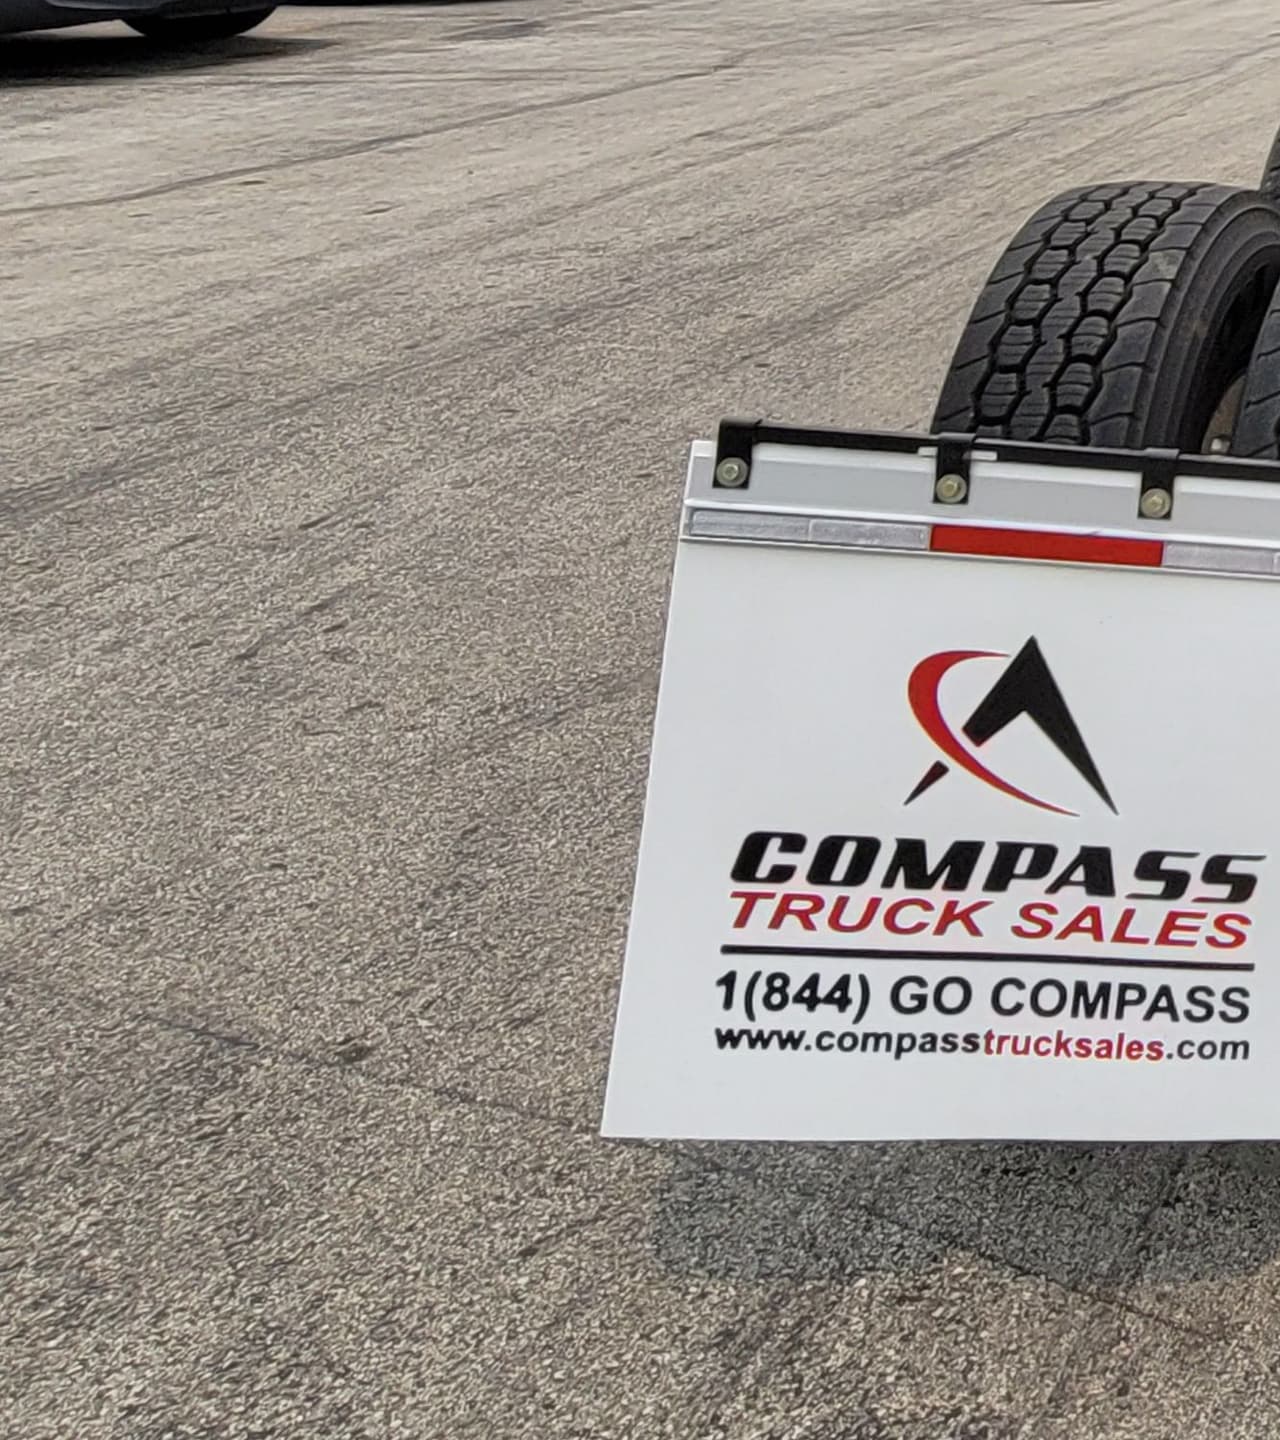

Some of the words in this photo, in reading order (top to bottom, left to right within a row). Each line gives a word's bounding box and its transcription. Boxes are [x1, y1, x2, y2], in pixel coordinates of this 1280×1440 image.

[730, 830, 1267, 905] COMPASS
[730, 891, 993, 937] TRUCK
[1010, 902, 1253, 949] SALES
[715, 970, 871, 1025] 1(844)
[889, 975, 973, 1016] GO
[990, 977, 1250, 1024] COMPASS
[714, 1027, 1250, 1062] www.compasstrucksales.com
